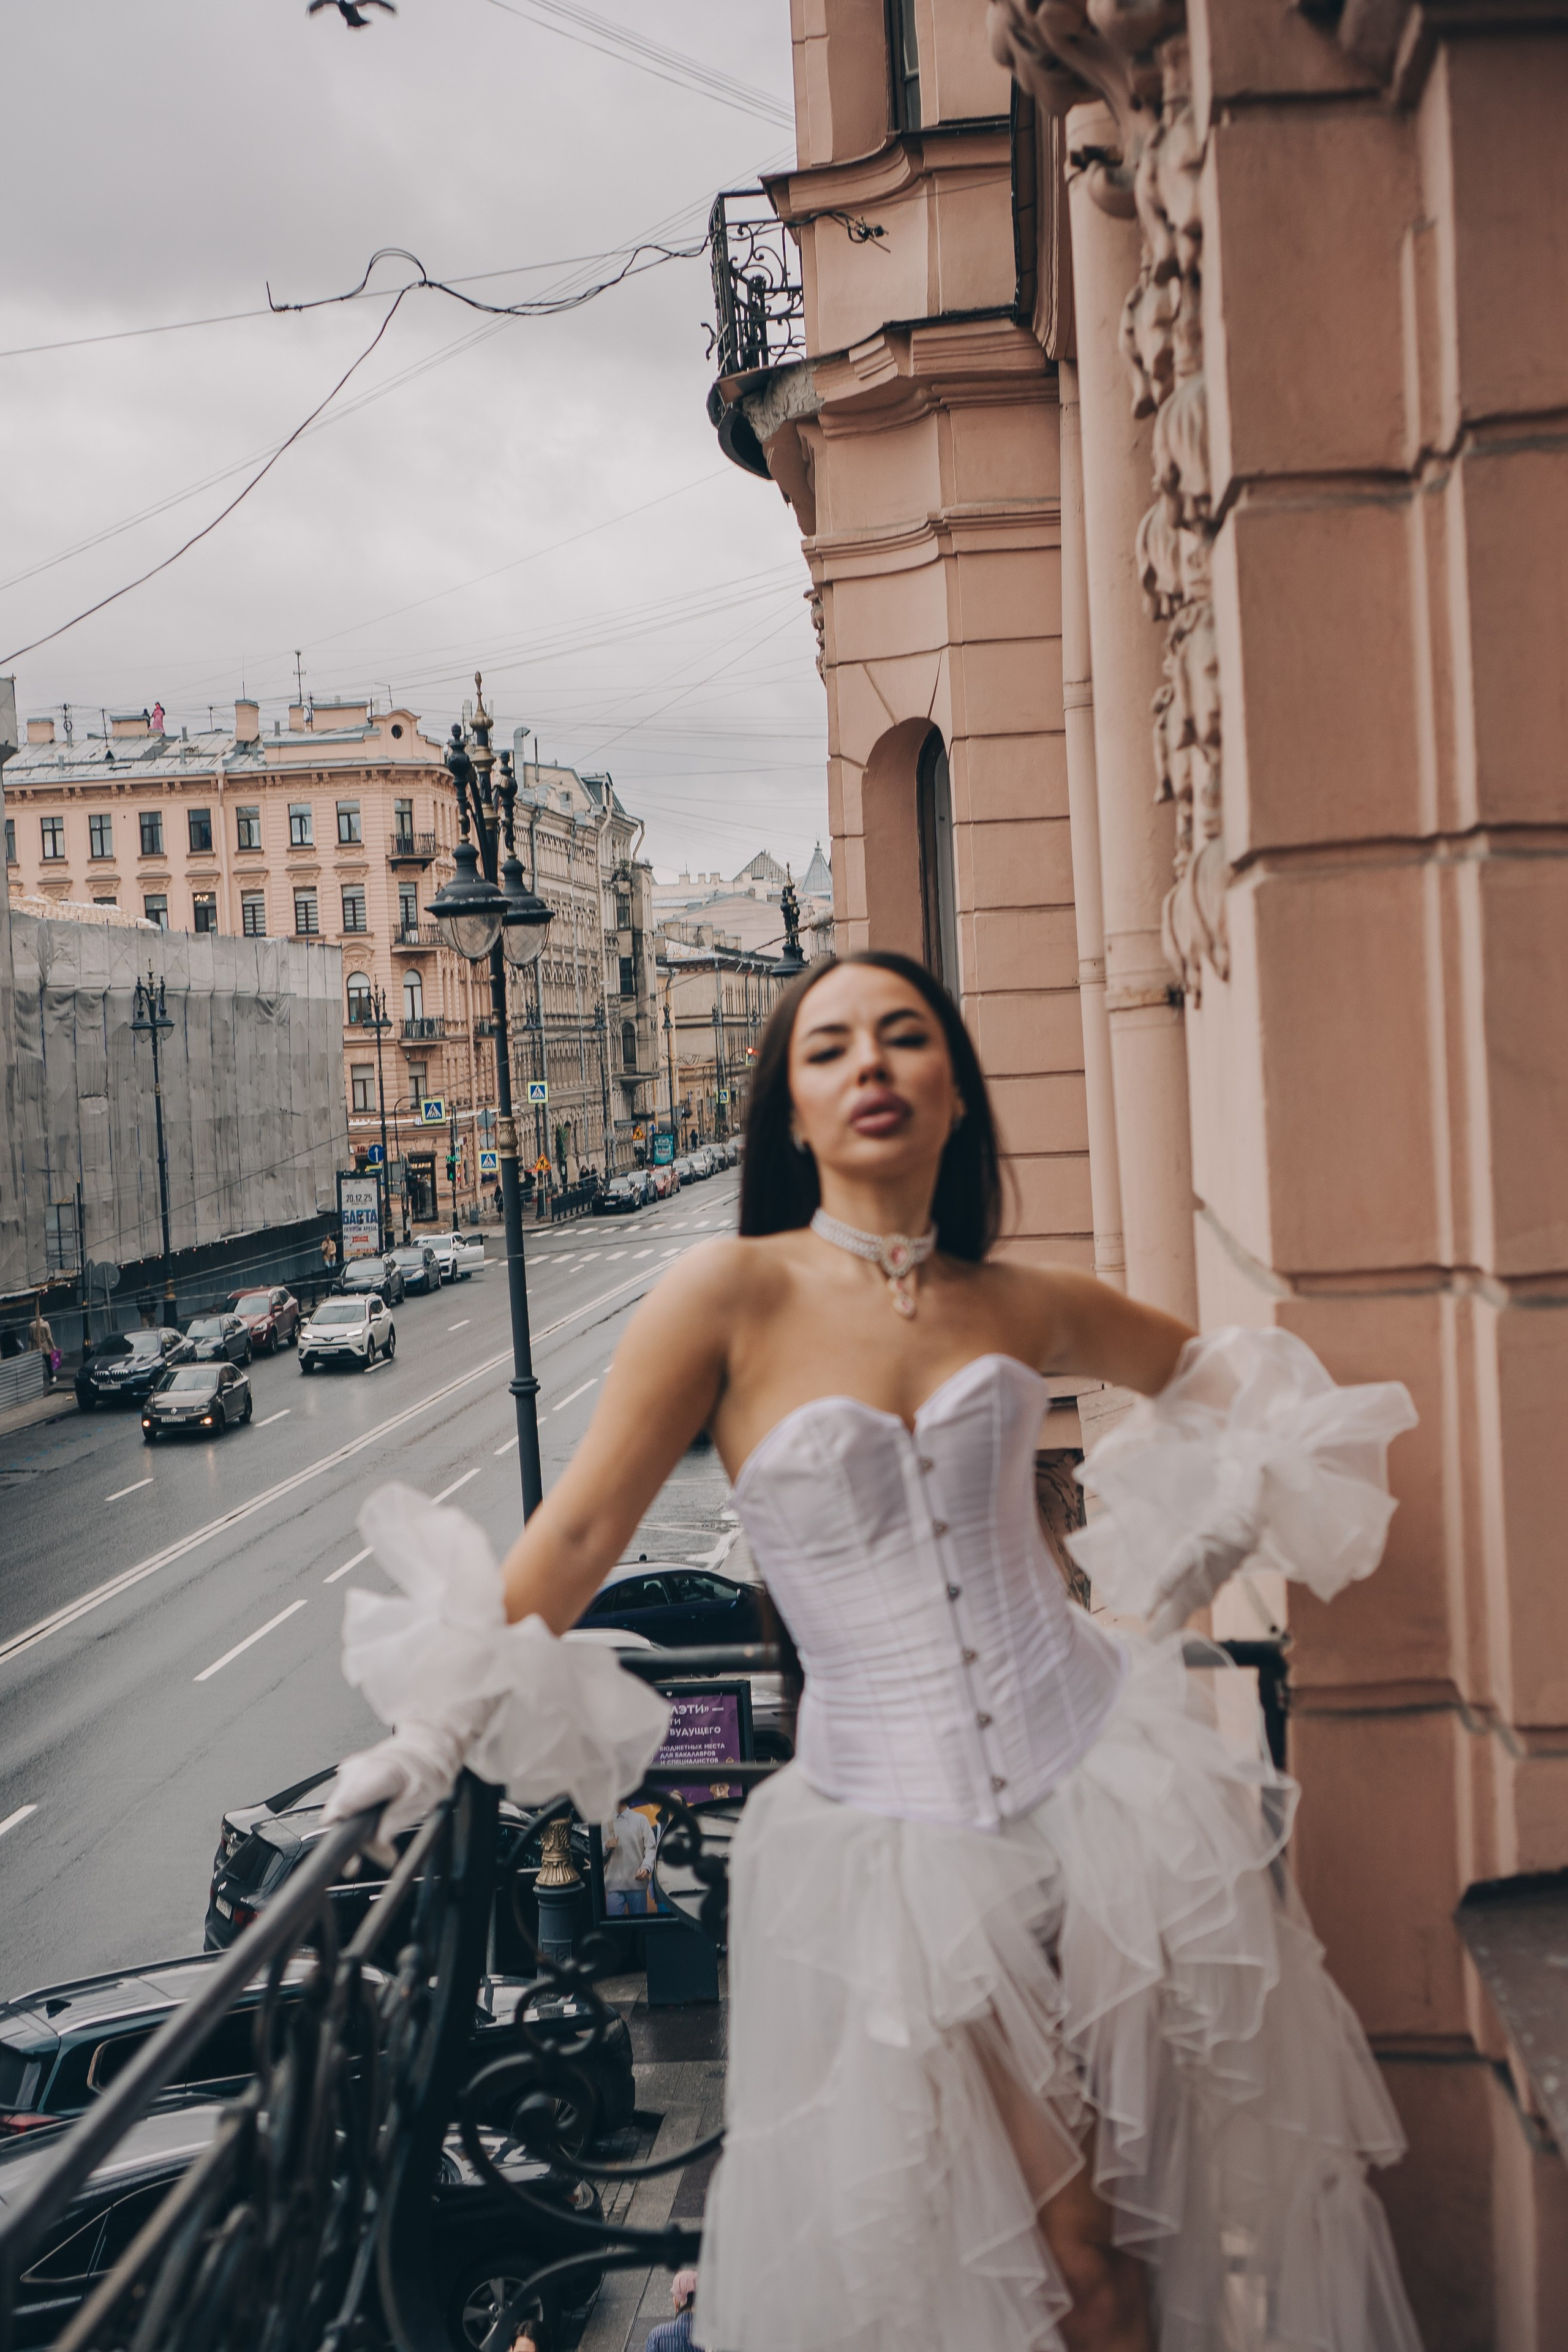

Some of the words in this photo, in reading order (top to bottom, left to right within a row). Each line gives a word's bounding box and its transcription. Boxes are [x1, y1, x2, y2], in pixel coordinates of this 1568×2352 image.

[346, 1193, 372, 1203] 20.12.25
[342, 1209, 377, 1224] БАСТА
[671, 1704, 709, 1715] ЛЭТИ»
[670, 1726, 721, 1737] БУДУЩЕГО
